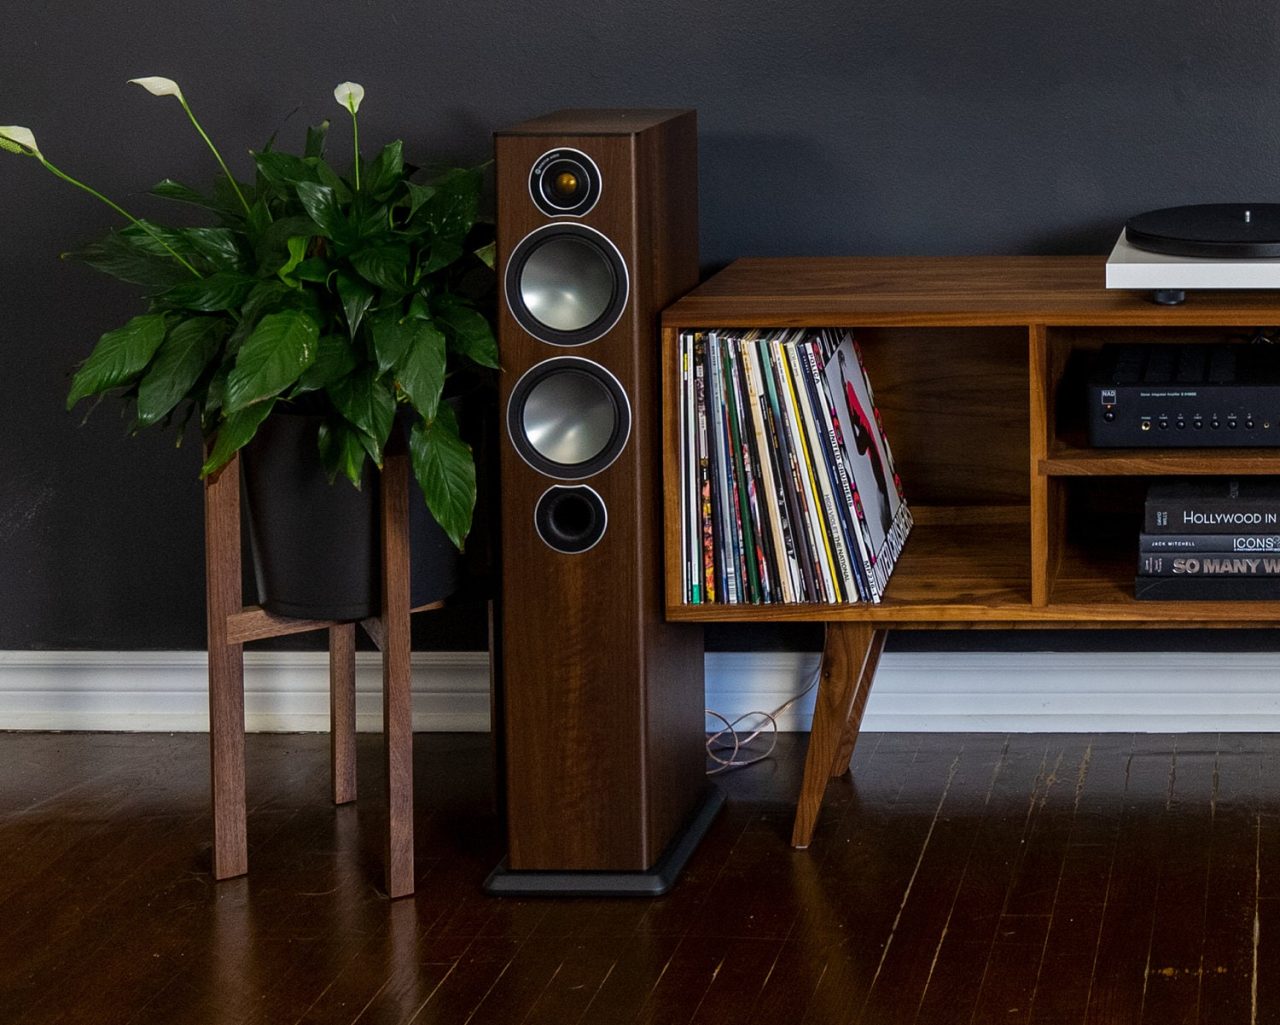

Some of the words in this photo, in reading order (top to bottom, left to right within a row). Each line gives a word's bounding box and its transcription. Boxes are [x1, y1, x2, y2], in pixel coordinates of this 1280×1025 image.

[828, 429, 841, 461] UNITED
[837, 462, 854, 508] CRUSHERS
[824, 494, 833, 510] HIGH
[828, 510, 839, 533] VIOLET
[1265, 513, 1277, 524] IN
[834, 533, 842, 545] THE
[1233, 537, 1274, 548] ICONS
[836, 545, 850, 582] NATIONAL
[1173, 559, 1200, 573] SO
[1203, 559, 1261, 573] MANY
